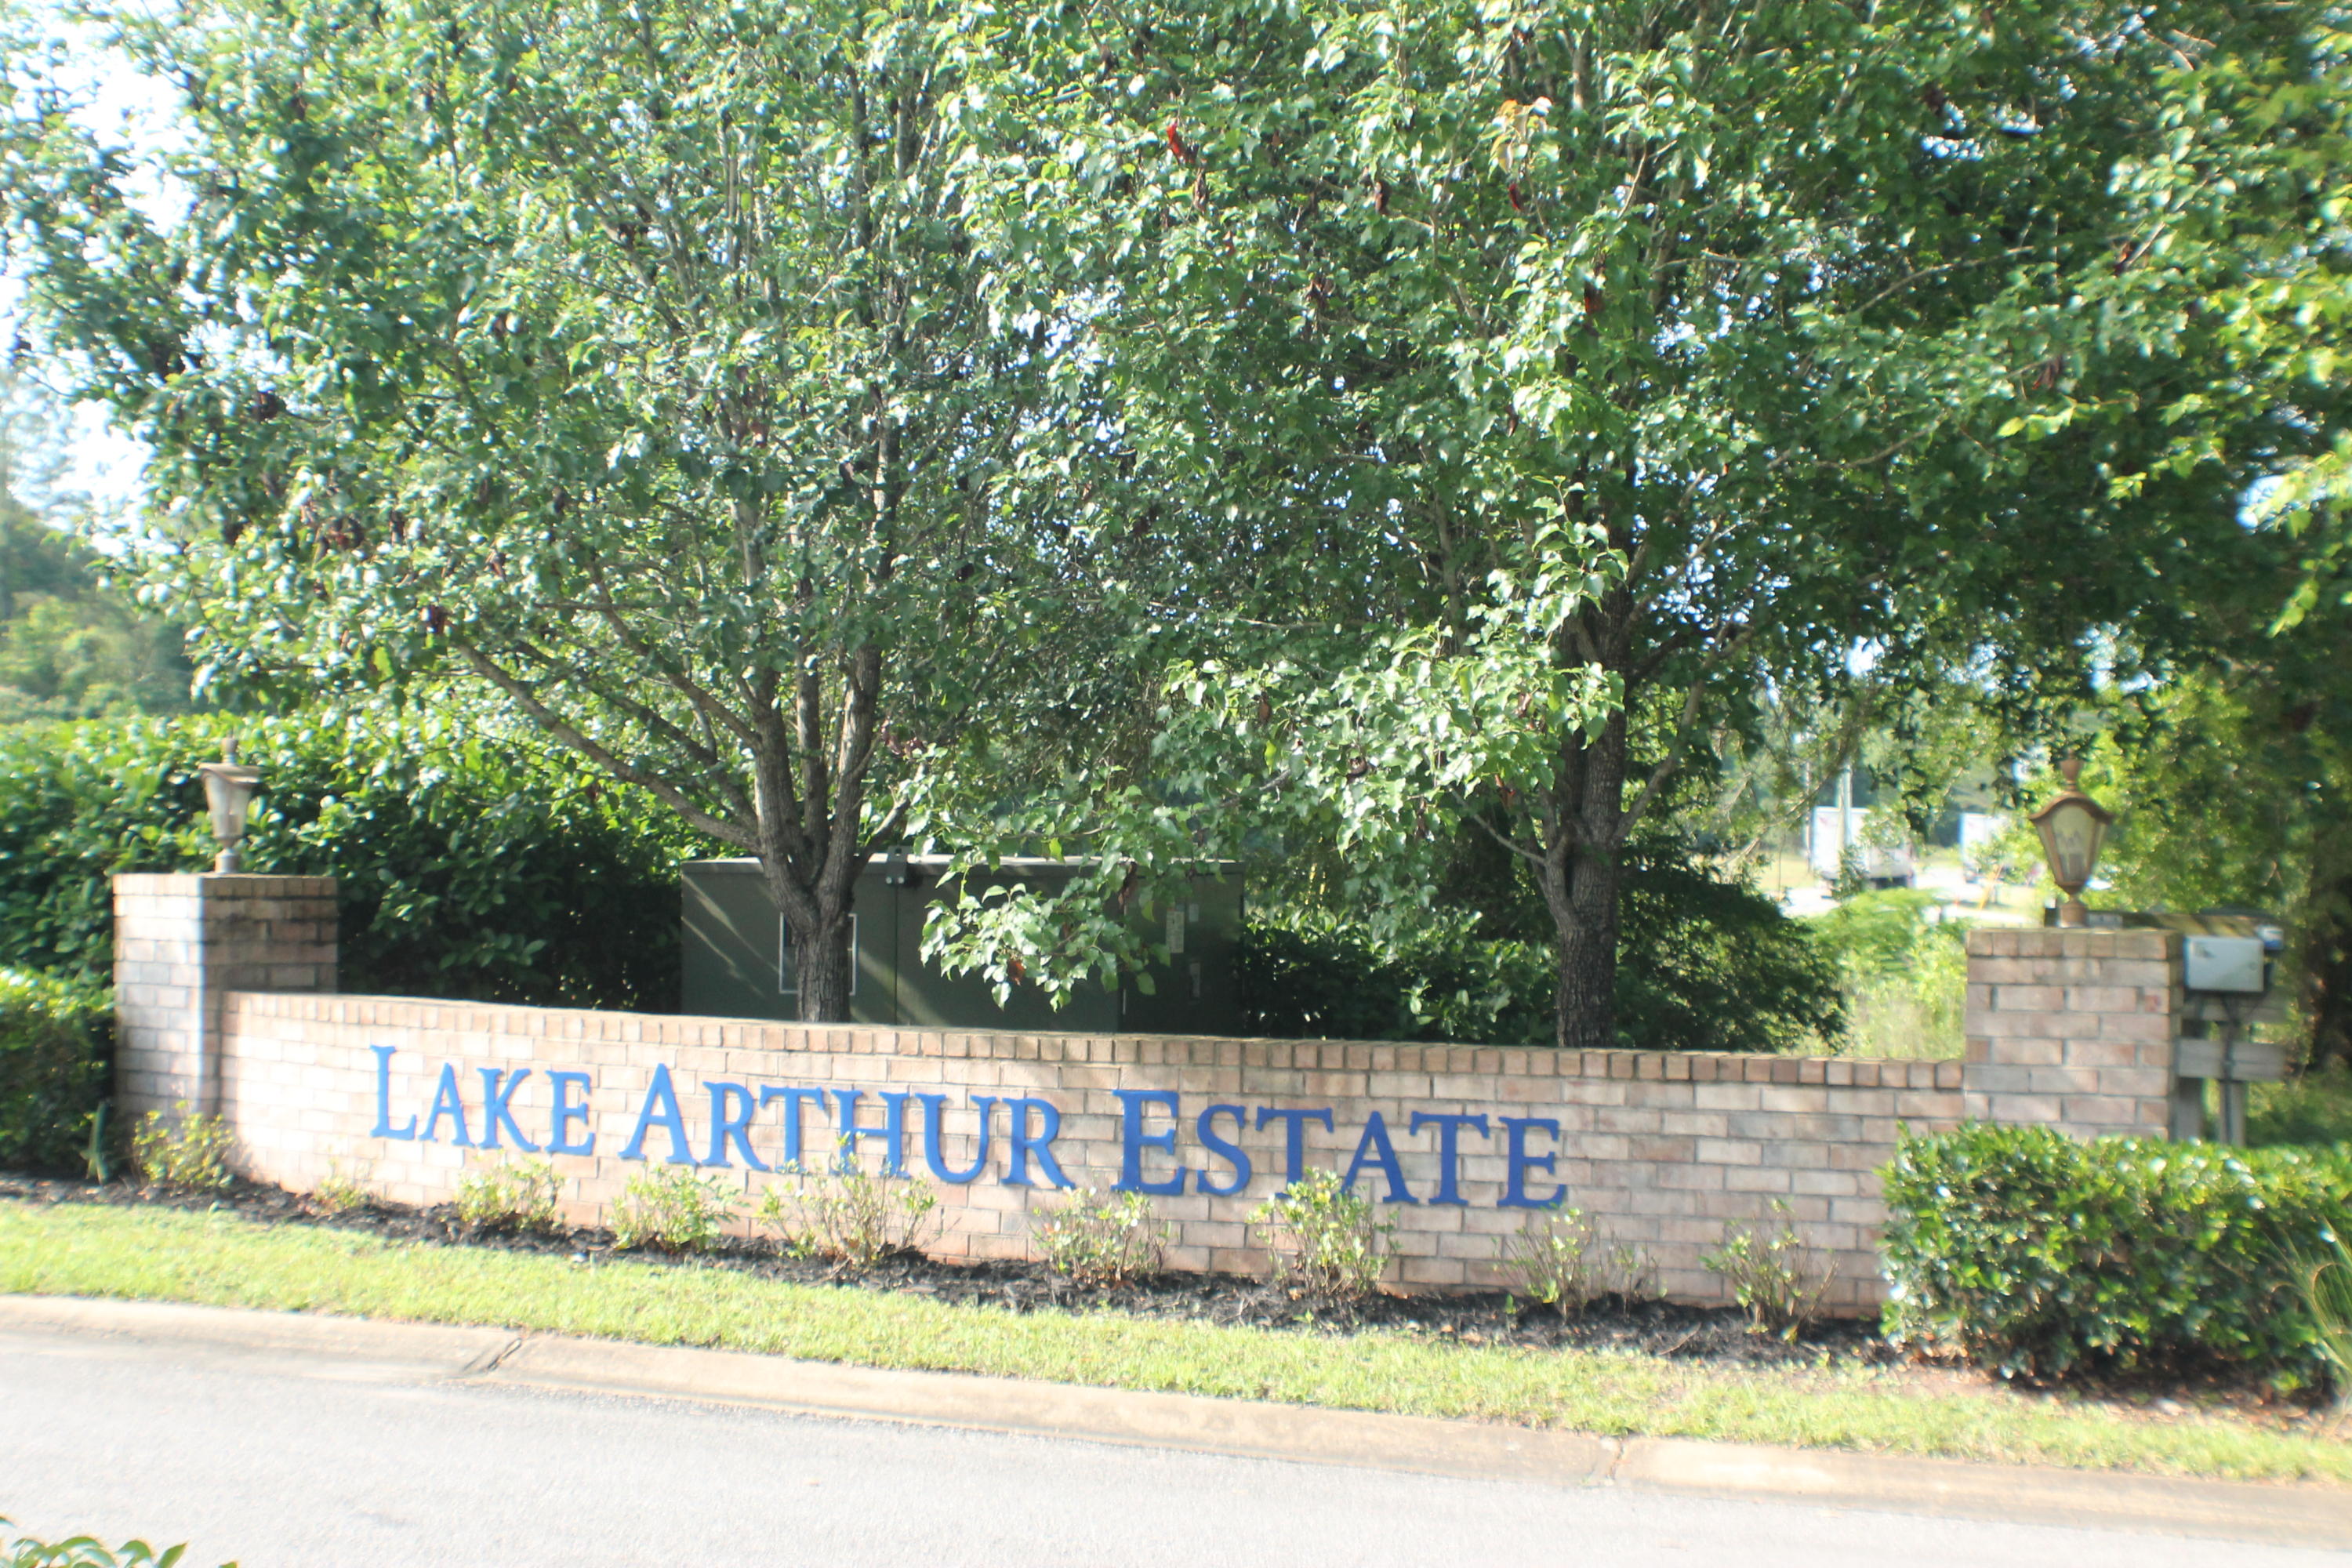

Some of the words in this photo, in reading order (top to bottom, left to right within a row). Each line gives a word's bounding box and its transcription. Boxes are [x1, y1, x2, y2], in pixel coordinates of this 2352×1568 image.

[370, 1044, 595, 1156] LAKE
[618, 1062, 1076, 1189] ARTHUR
[1111, 1088, 1566, 1210] ESTATE
